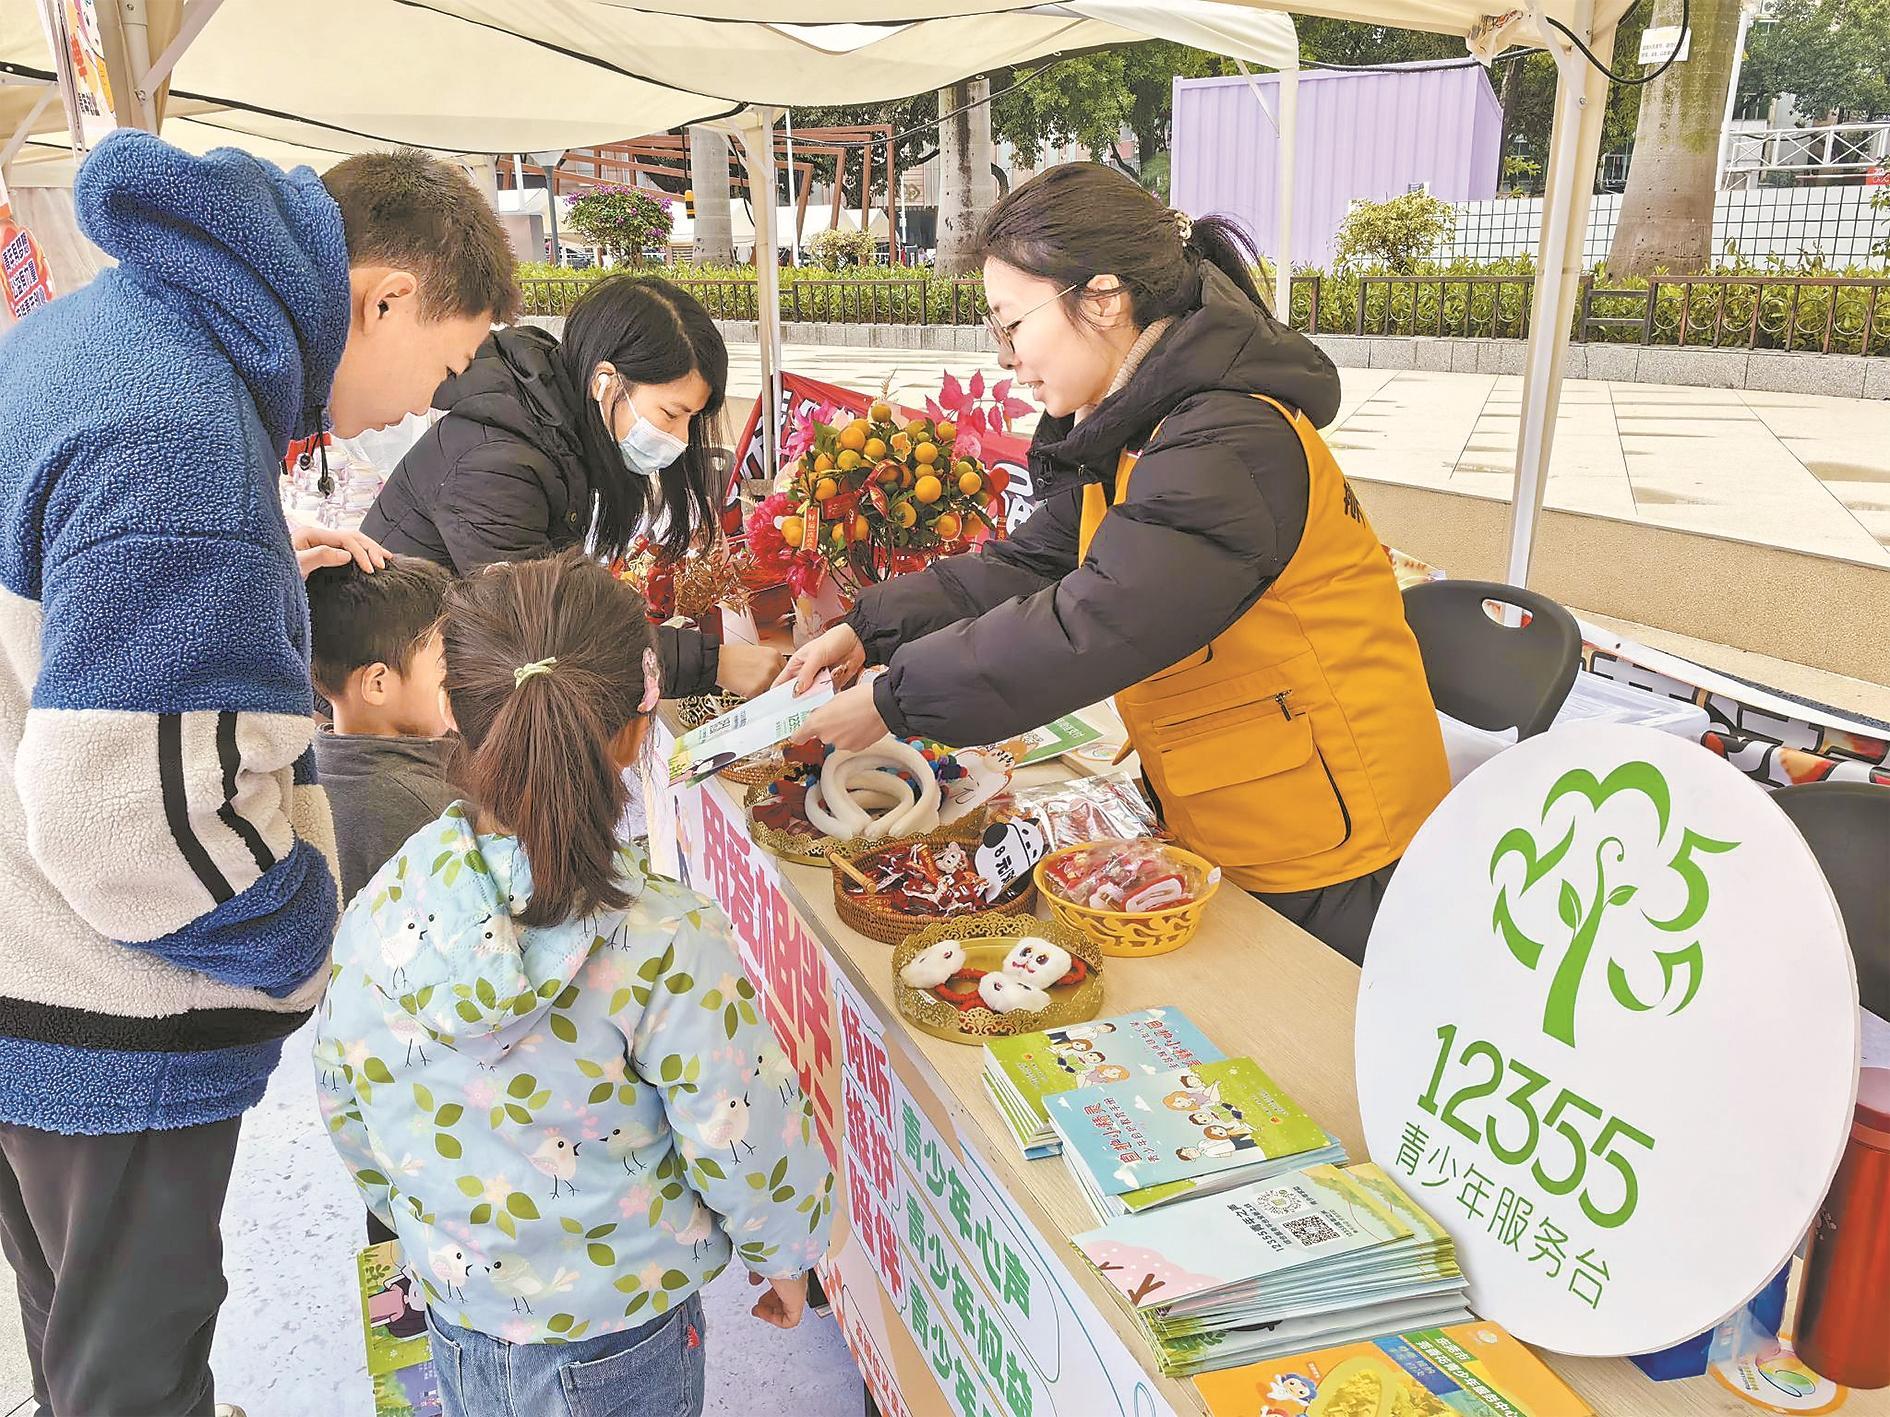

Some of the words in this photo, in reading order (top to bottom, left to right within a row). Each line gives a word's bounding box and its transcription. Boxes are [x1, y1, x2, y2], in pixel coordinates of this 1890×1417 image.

[700, 782, 833, 1078] 用爱相伴
[841, 993, 894, 1132] 倾听
[901, 1098, 1031, 1320] 青少年心声
[1083, 1102, 1143, 1164] 自护小精灵
[1226, 1203, 1285, 1252] 12355青年之声
[1395, 1120, 1612, 1310] 青少年服务台
[1417, 1024, 1656, 1229] 12355
[846, 1086, 895, 1200] 维护
[905, 1189, 1033, 1417] 青少年权益
[847, 1153, 903, 1300] 陪伴
[909, 1275, 992, 1417] 青少年
[1434, 1337, 1469, 1362] 东莞市
